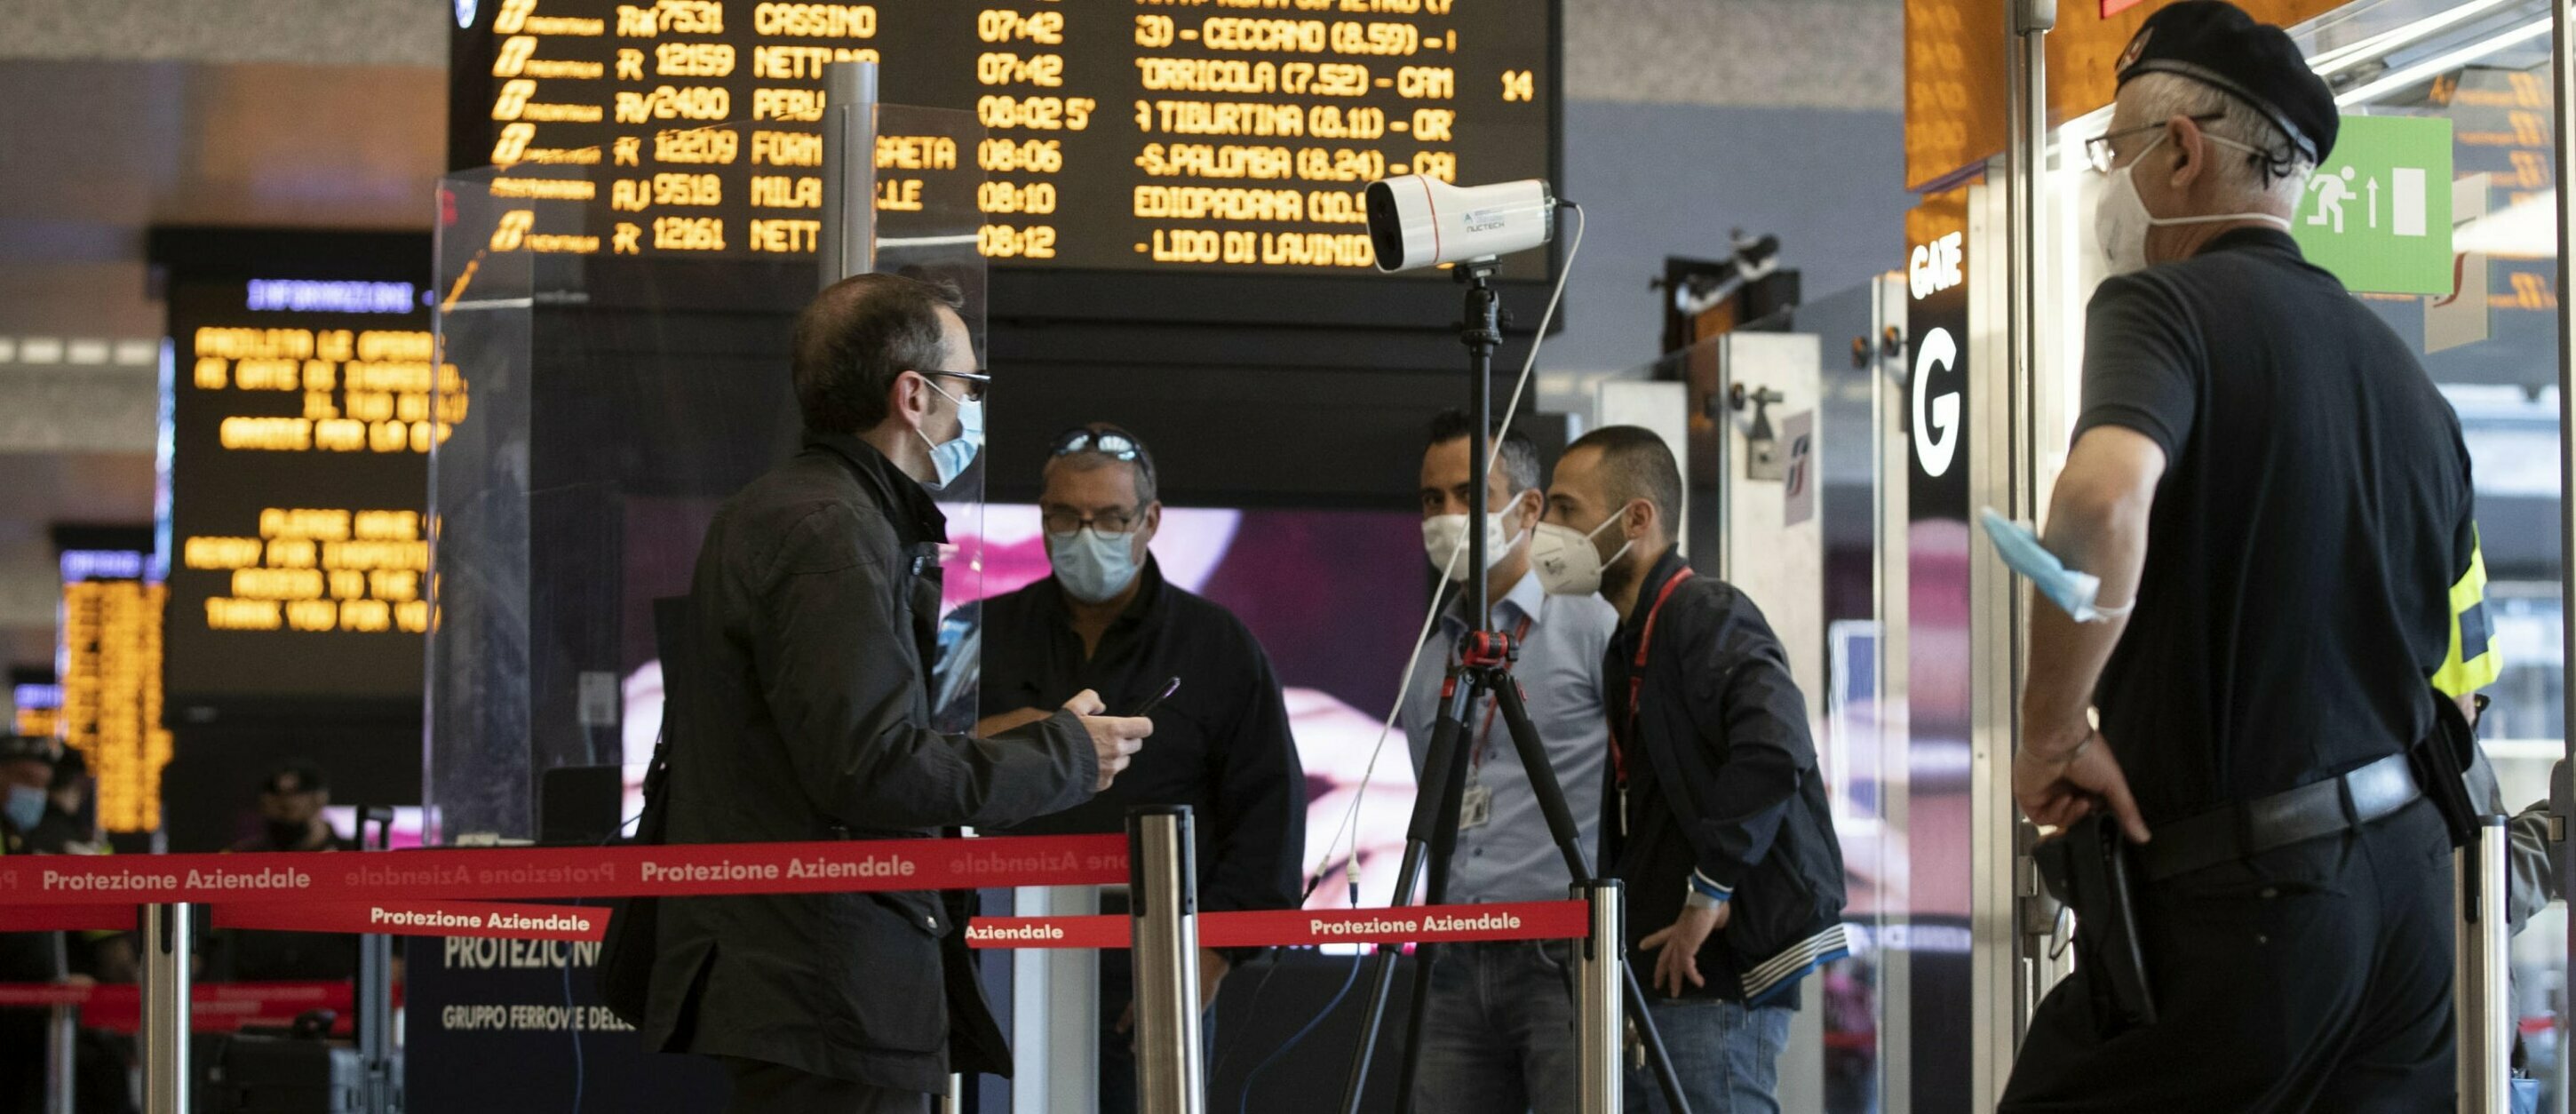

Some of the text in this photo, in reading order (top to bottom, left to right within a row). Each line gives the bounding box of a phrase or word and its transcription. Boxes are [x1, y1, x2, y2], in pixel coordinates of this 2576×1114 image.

[657, 0, 724, 34] 7531
[754, 3, 877, 38] CASSINO
[978, 10, 1063, 44] 07:42
[1204, 17, 1326, 52] CECCANO
[1331, 21, 1419, 56] (8.59)
[616, 48, 645, 81] R
[656, 43, 735, 77] 12159
[978, 52, 1063, 87] 07:42
[1281, 62, 1369, 97] (7.52)
[1397, 66, 1454, 99] CAM
[1501, 70, 1533, 101] 14
[655, 85, 730, 120] 2480
[978, 95, 1062, 130] 08:02
[1156, 100, 1303, 138] TIBURTINA
[1308, 106, 1384, 139] (8.11)
[613, 137, 640, 167] R
[655, 128, 738, 164] 12209
[978, 139, 1062, 172] 08:06
[1297, 147, 1384, 181] (8.24)
[654, 172, 721, 206] 9518
[978, 181, 1056, 214] 08:10
[1134, 186, 1302, 221] EDIOPADANA
[612, 222, 641, 255] R
[654, 217, 726, 251] 12161
[977, 225, 1056, 259] 08:12
[1153, 228, 1220, 263] LIDO
[1223, 232, 1256, 264] DI
[1910, 230, 1961, 300] GATE
[1912, 327, 1960, 477] G
[44, 867, 312, 890] Protezione Aziendale
[641, 854, 915, 882] Protezione Aziendale
[370, 906, 590, 932] Protezione Aziendale
[965, 923, 1064, 940] Aziendale
[1310, 912, 1521, 935] Protezione Aziendale
[442, 1005, 506, 1030] GRUPPO
[589, 1006, 636, 1031] DEL
